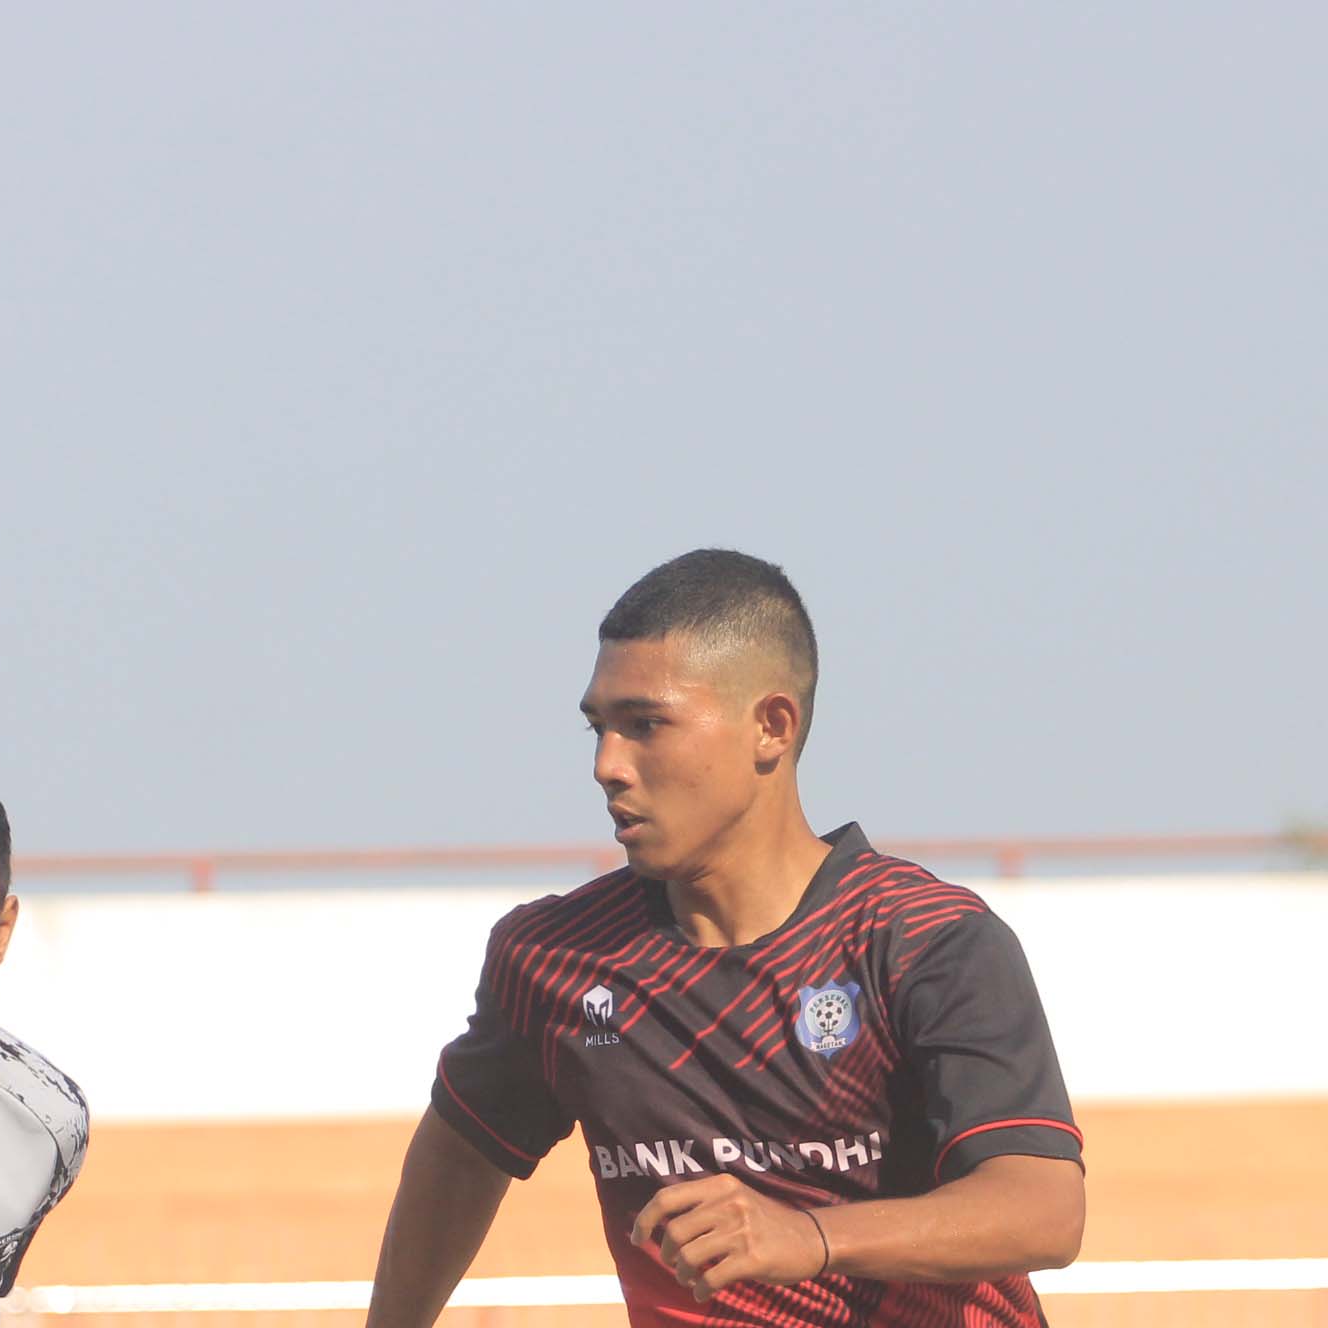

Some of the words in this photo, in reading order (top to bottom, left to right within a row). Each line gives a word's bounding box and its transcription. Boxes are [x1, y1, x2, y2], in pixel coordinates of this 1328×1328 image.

[586, 1033, 620, 1047] MILLS
[596, 1139, 704, 1179] BANK
[713, 1131, 882, 1173] PUNDHI
